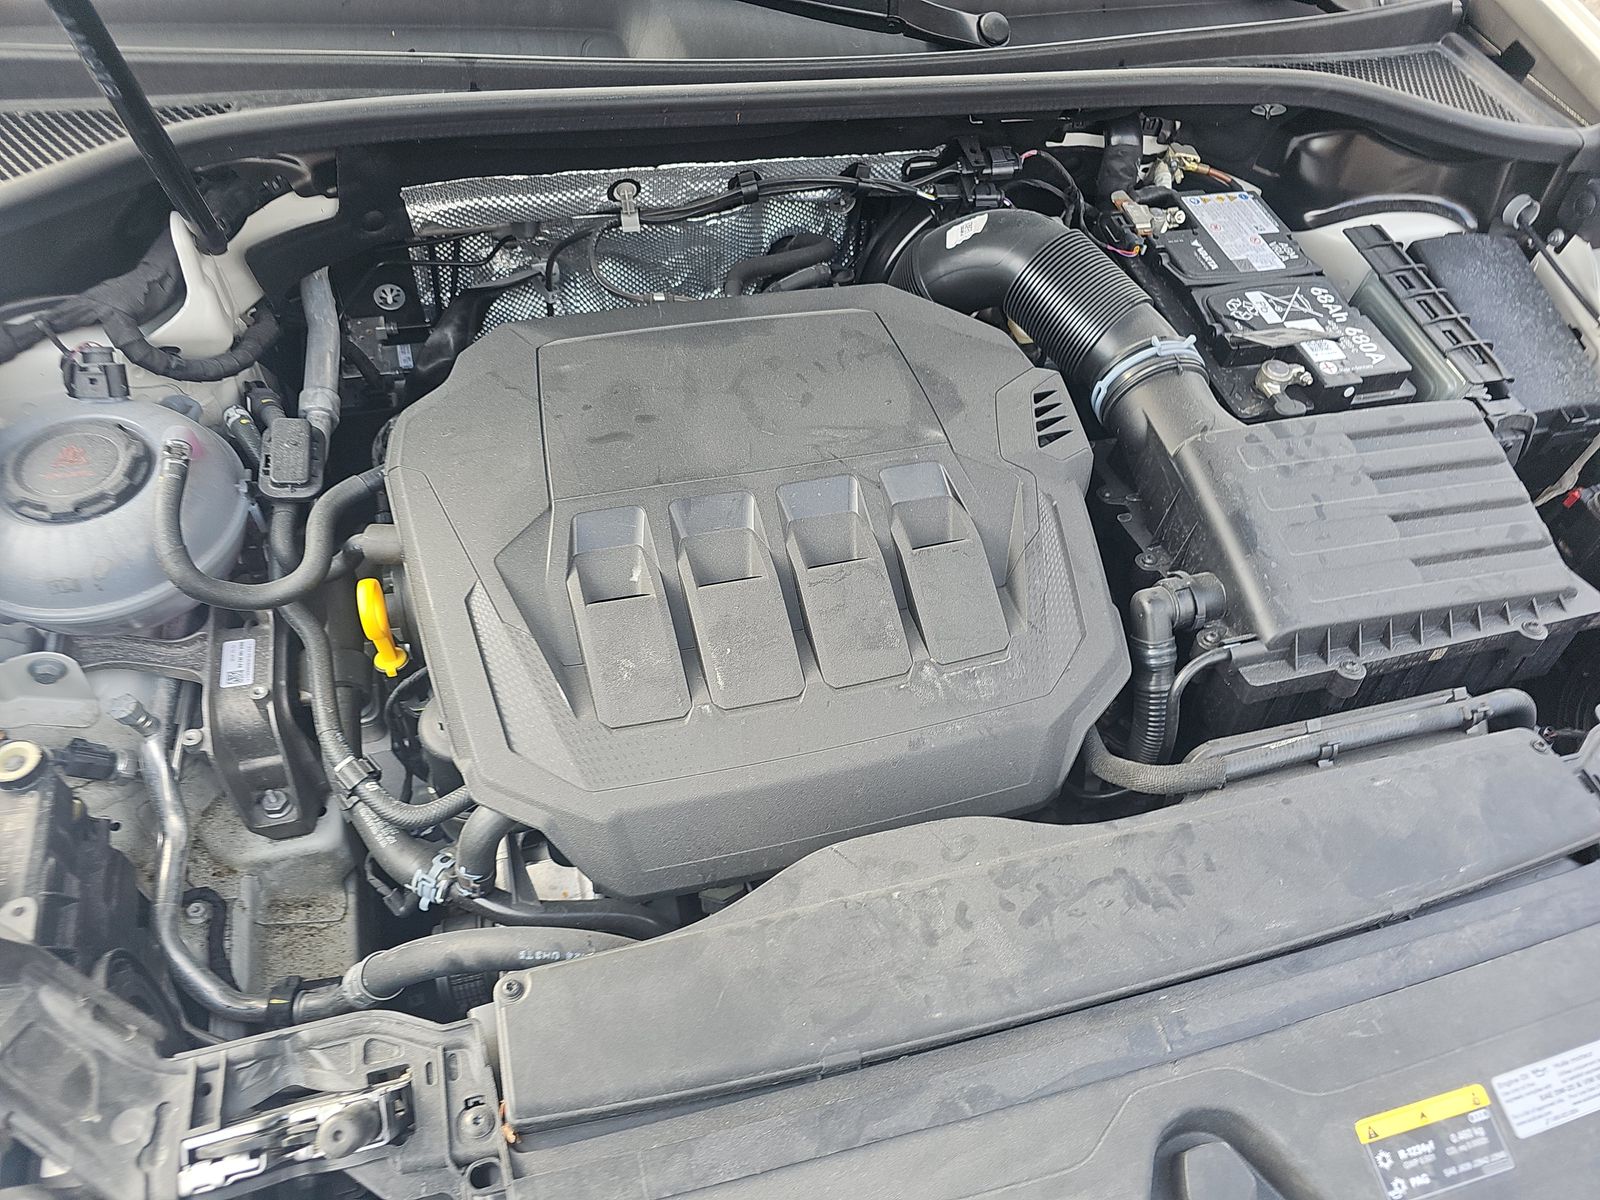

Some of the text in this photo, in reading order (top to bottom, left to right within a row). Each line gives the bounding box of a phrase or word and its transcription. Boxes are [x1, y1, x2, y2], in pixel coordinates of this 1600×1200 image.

[1197, 245, 1219, 271] VARTA
[1310, 286, 1349, 323] 68Ah
[1344, 326, 1386, 366] 680A
